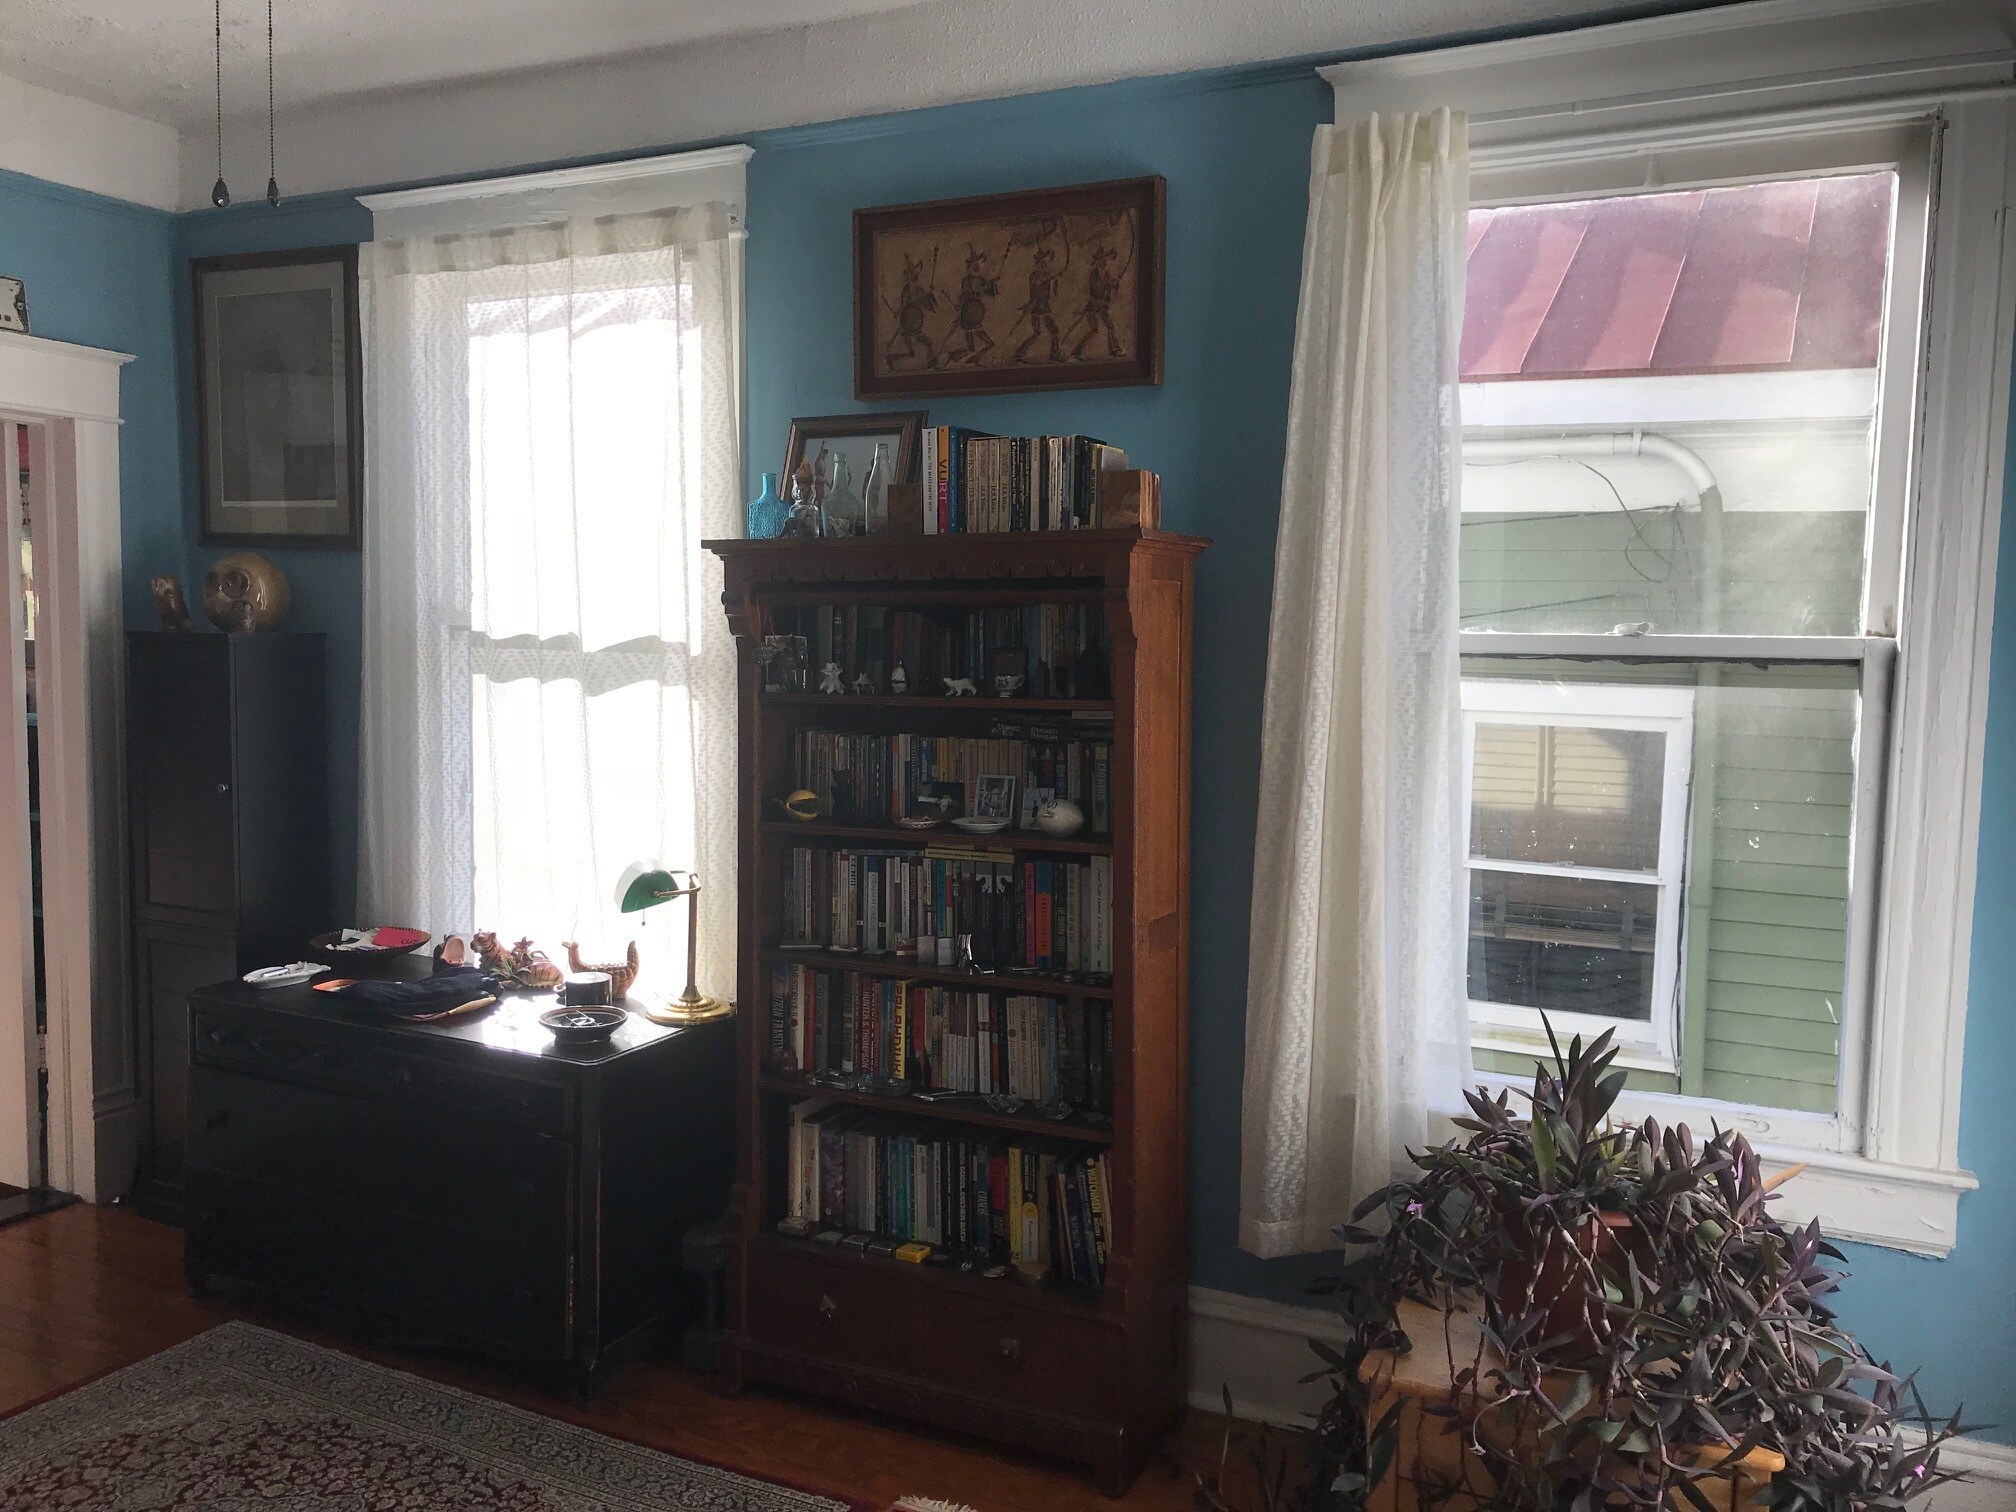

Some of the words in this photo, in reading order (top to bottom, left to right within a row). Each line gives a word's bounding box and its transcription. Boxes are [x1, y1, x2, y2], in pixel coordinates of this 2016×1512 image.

[939, 459, 947, 504] VURT
[862, 991, 870, 1020] HUNTER
[862, 1028, 870, 1068] THOMPSON
[1086, 1168, 1102, 1213] WATCHMEN
